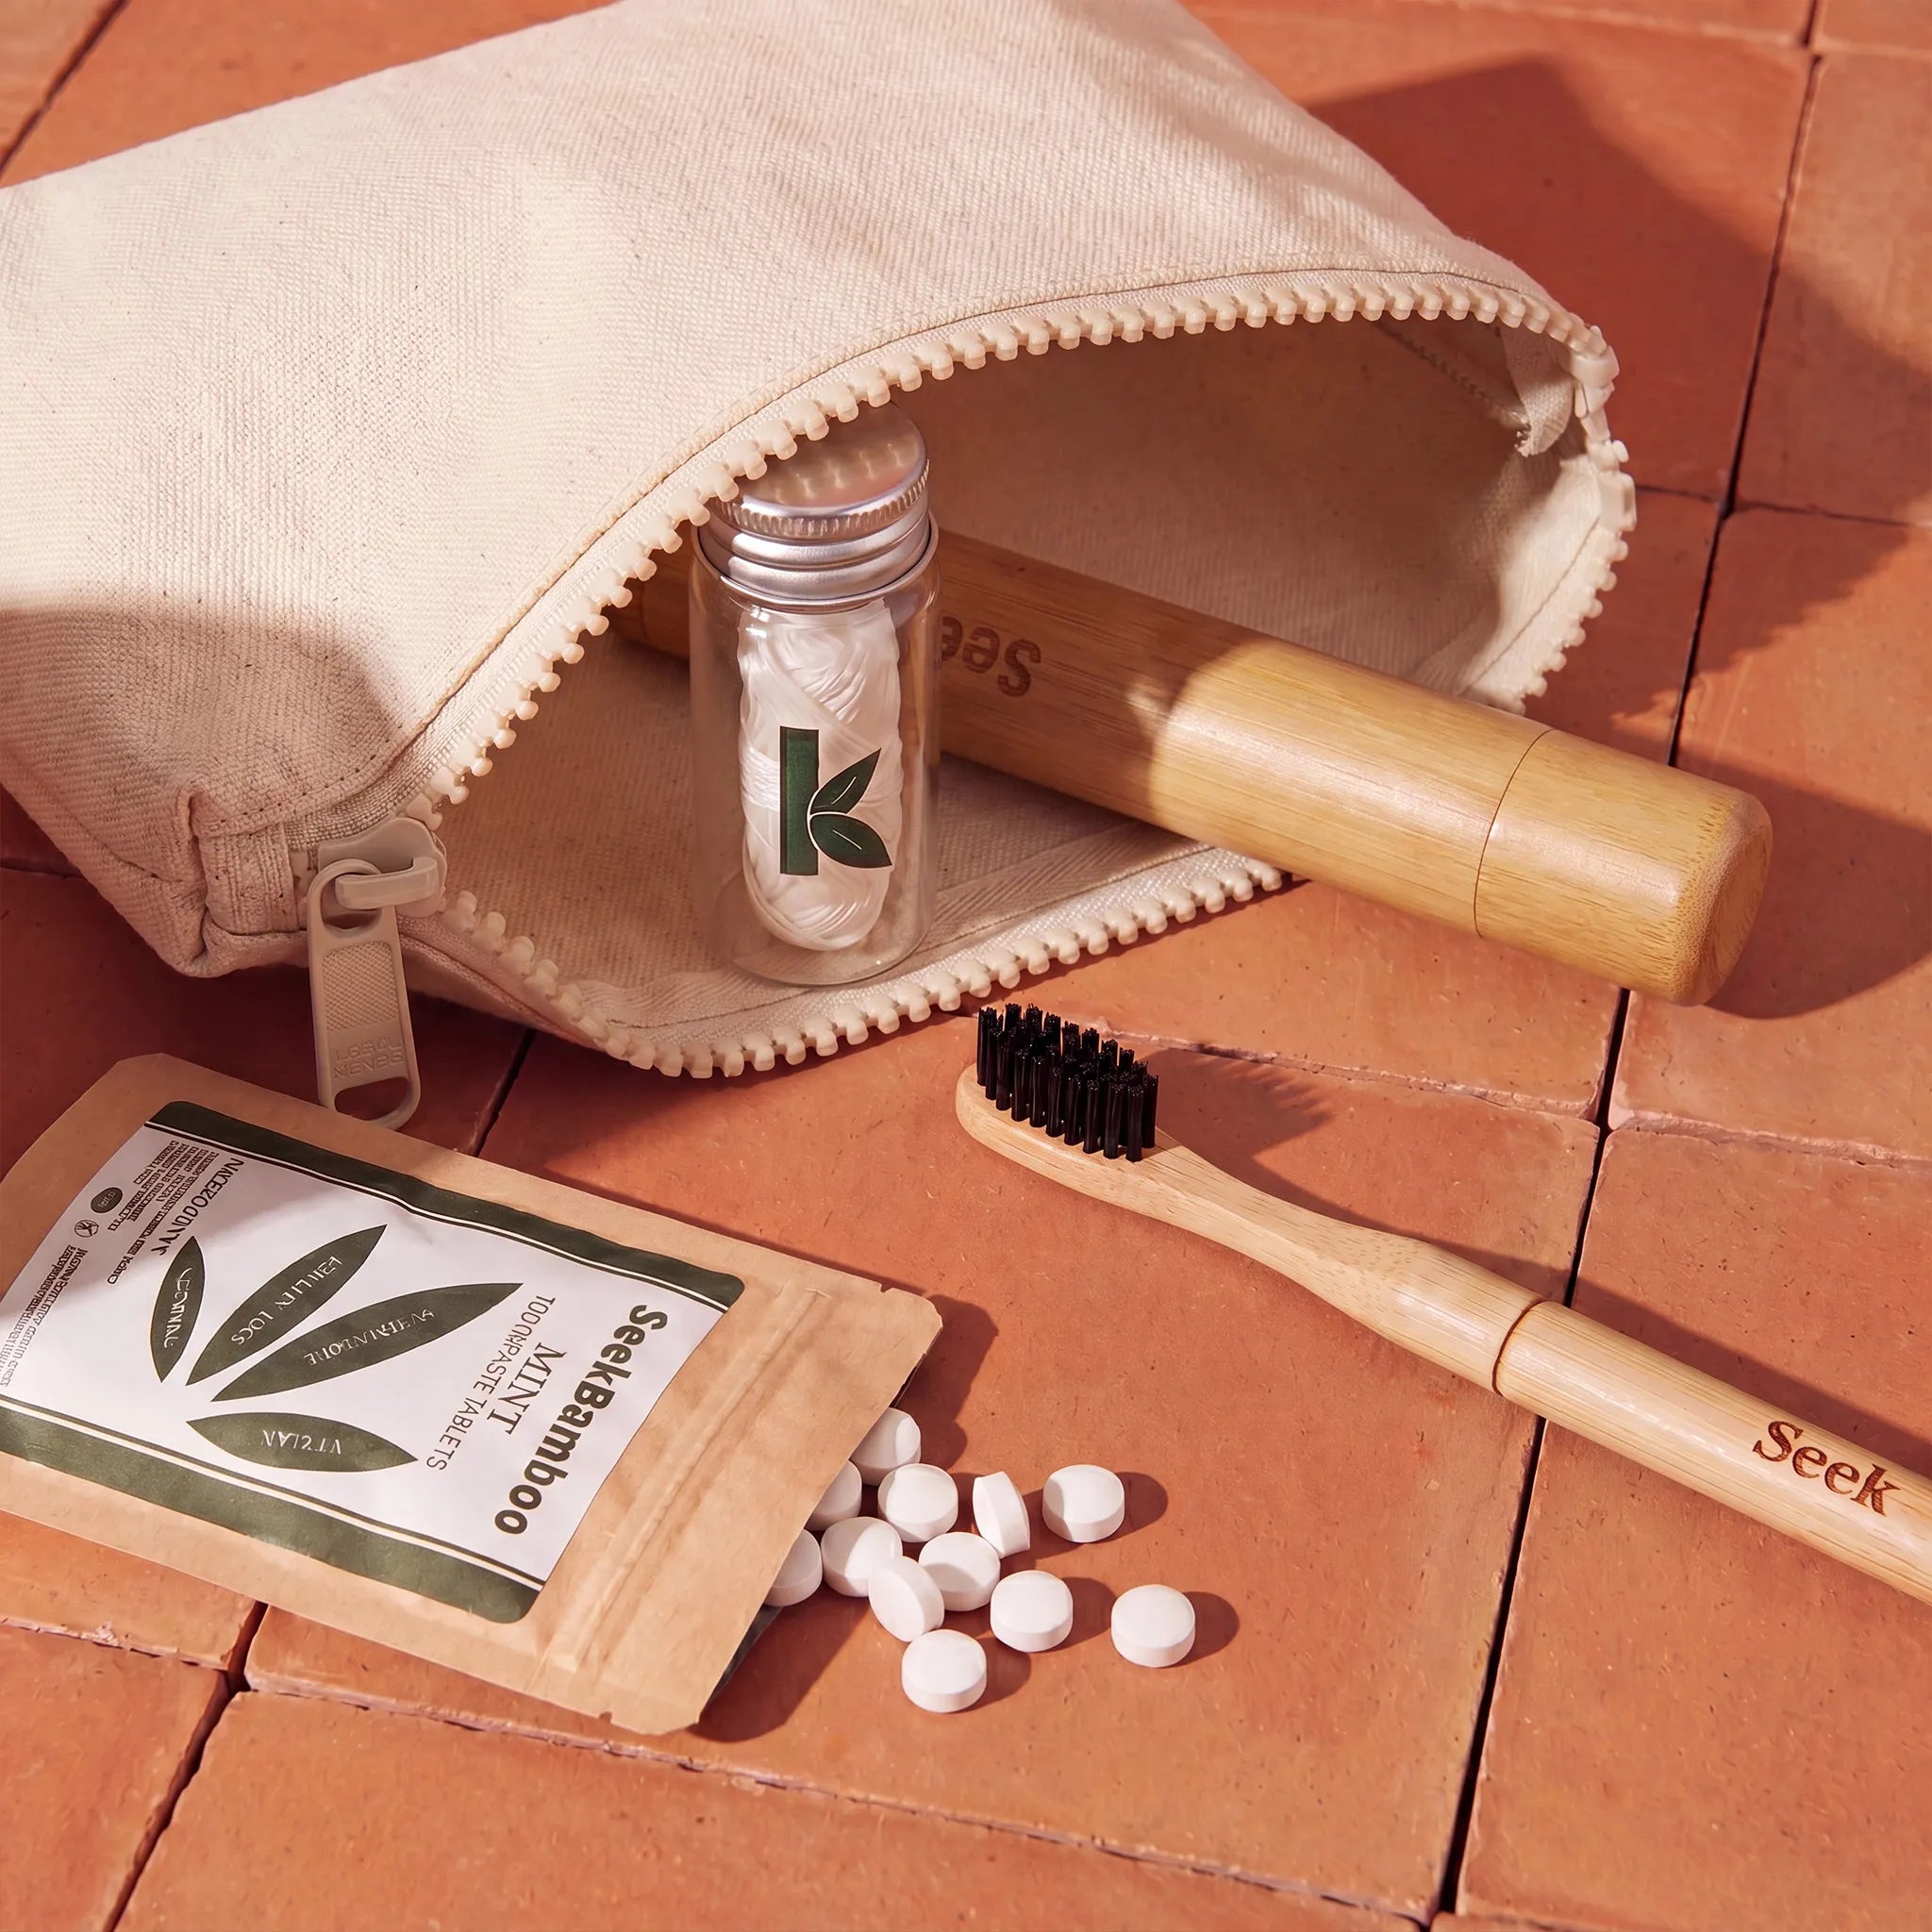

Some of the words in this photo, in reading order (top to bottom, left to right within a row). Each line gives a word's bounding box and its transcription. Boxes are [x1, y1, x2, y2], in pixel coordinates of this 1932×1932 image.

[941, 616, 1041, 697] See
[426, 1397, 488, 1471] TABLETS
[486, 1341, 568, 1435] MINT
[494, 1305, 668, 1535] SeekBamboo
[1753, 1421, 1901, 1517] Seek
